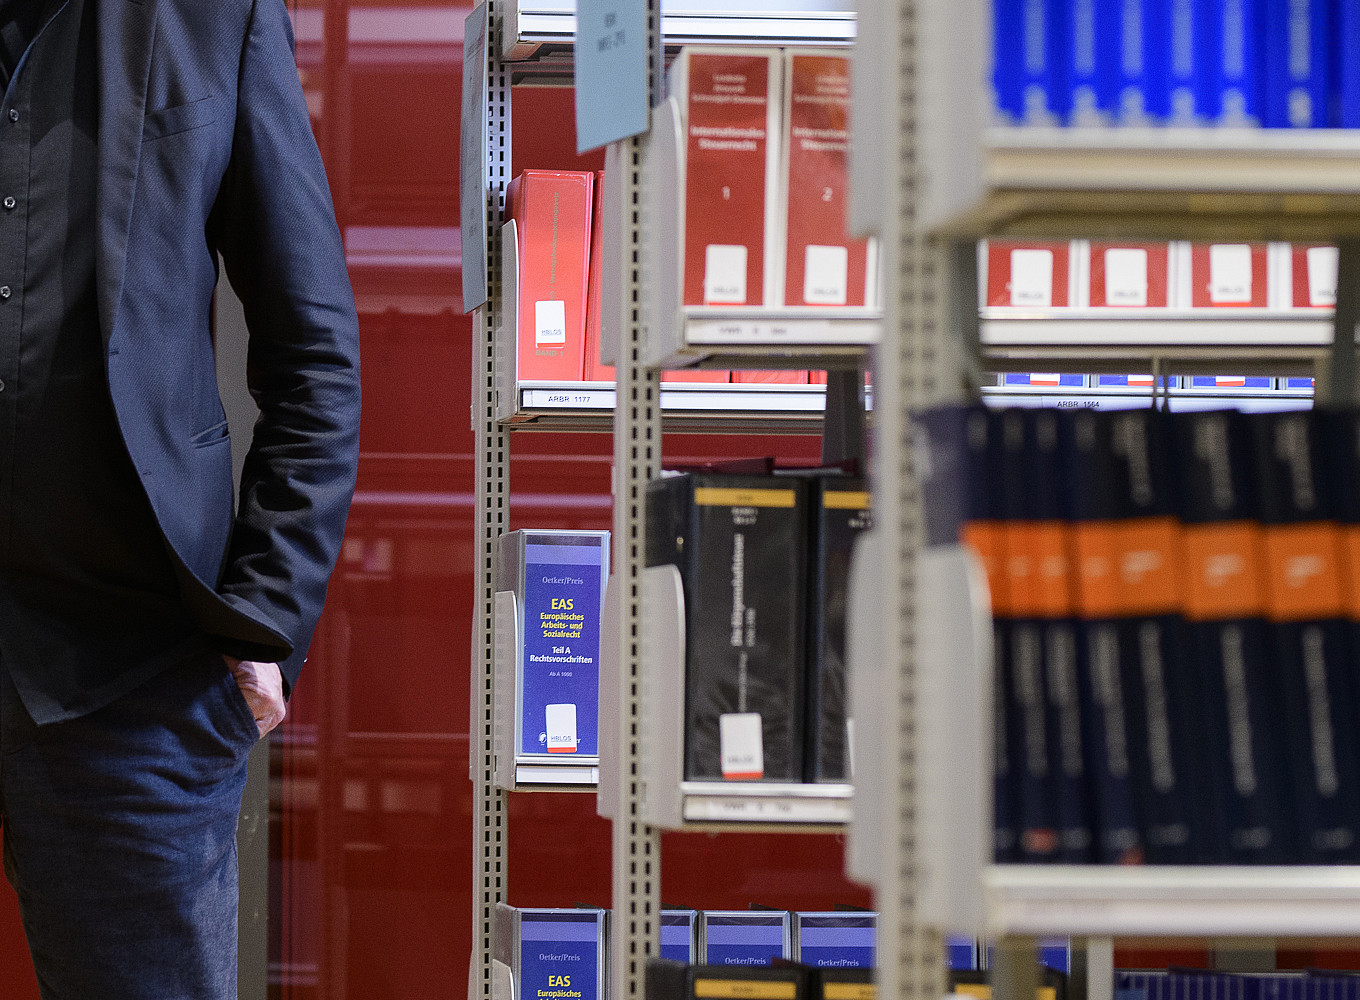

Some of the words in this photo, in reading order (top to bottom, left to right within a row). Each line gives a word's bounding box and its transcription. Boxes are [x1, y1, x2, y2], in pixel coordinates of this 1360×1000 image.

[721, 186, 730, 200] 1
[822, 186, 833, 201] 2
[542, 576, 584, 585] Oetker/Preis
[551, 598, 574, 610] EAS
[540, 612, 585, 621] Europäisches
[541, 621, 568, 629] Arbeits-
[569, 622, 583, 630] und
[543, 630, 581, 638] Sozialrecht
[552, 646, 564, 654] Teil
[530, 655, 593, 664] Rechtsvorschriften
[539, 953, 581, 961] Oetker/Preis
[724, 957, 767, 965] Oetker/Preis
[817, 959, 860, 967] Oetker/Preis
[548, 975, 571, 987] EAS
[537, 989, 582, 998] Europäisches
